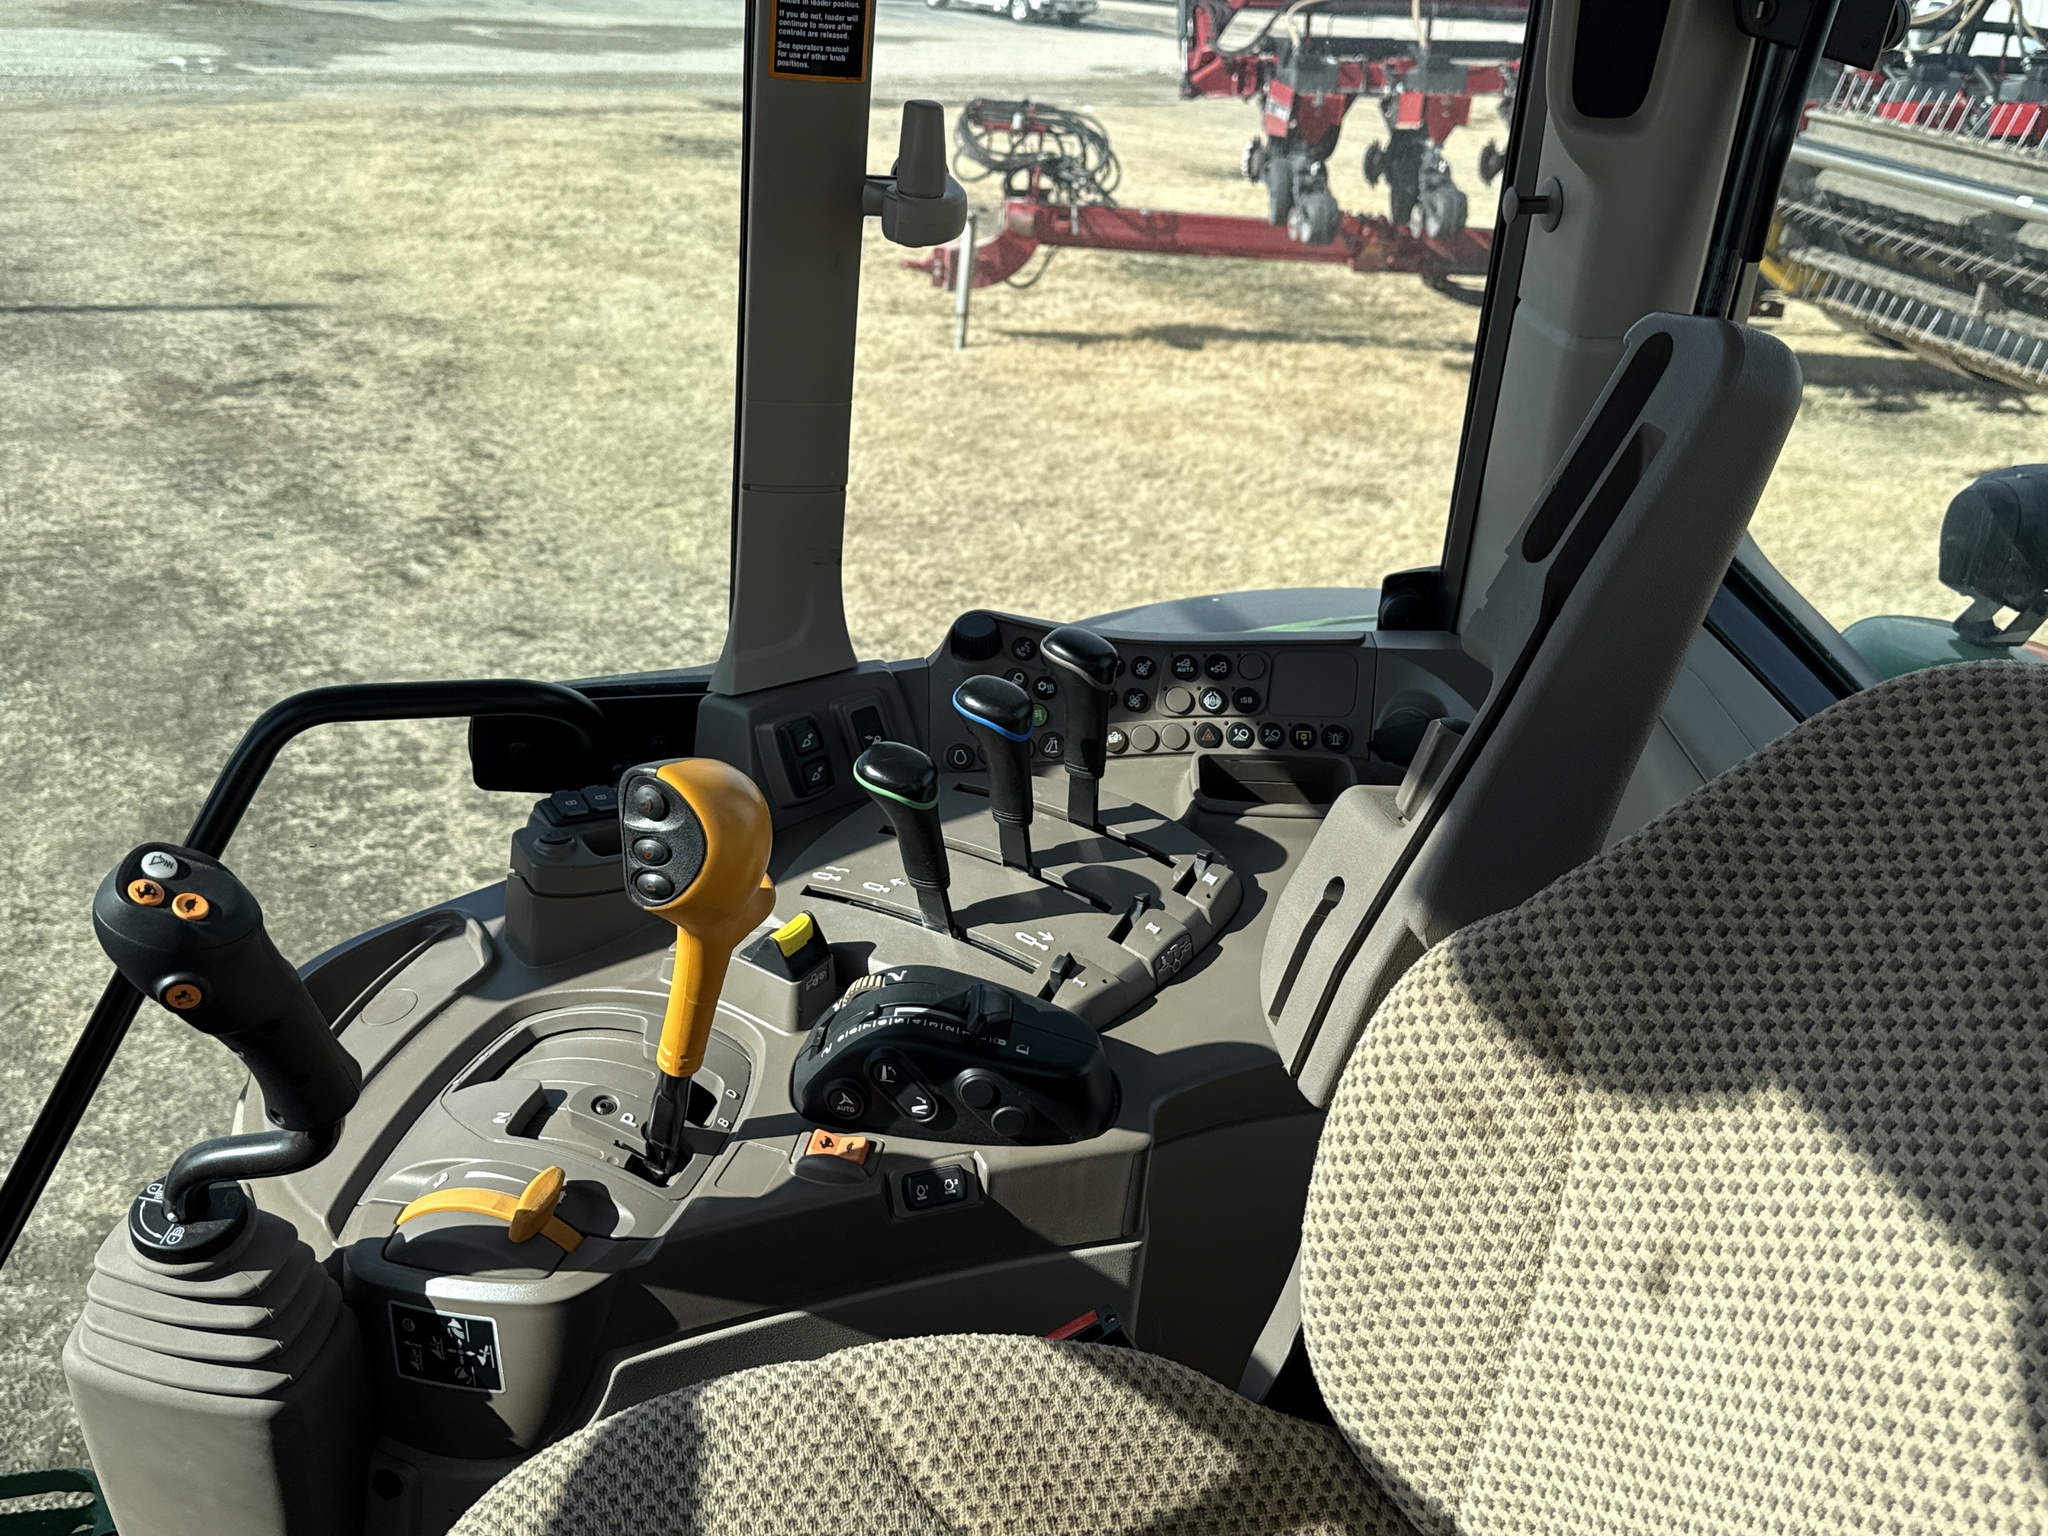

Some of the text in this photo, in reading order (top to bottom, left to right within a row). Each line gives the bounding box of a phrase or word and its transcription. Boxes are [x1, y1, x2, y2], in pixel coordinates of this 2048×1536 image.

[779, 9, 785, 17] If
[800, 11, 809, 19] do
[824, 13, 845, 21] loader
[778, 20, 808, 28] continue
[837, 23, 853, 31] after
[820, 31, 850, 40] released.
[778, 41, 790, 49] See
[825, 45, 849, 53] manual
[777, 59, 809, 68] positions.
[1176, 665, 1195, 673] AUTO
[928, 1020, 939, 1028] 3
[945, 1024, 956, 1033] 2
[725, 1088, 737, 1099] D
[836, 1104, 856, 1113] AUTO
[492, 1111, 512, 1124] N
[619, 1112, 638, 1128] P
[717, 1116, 730, 1128] B
